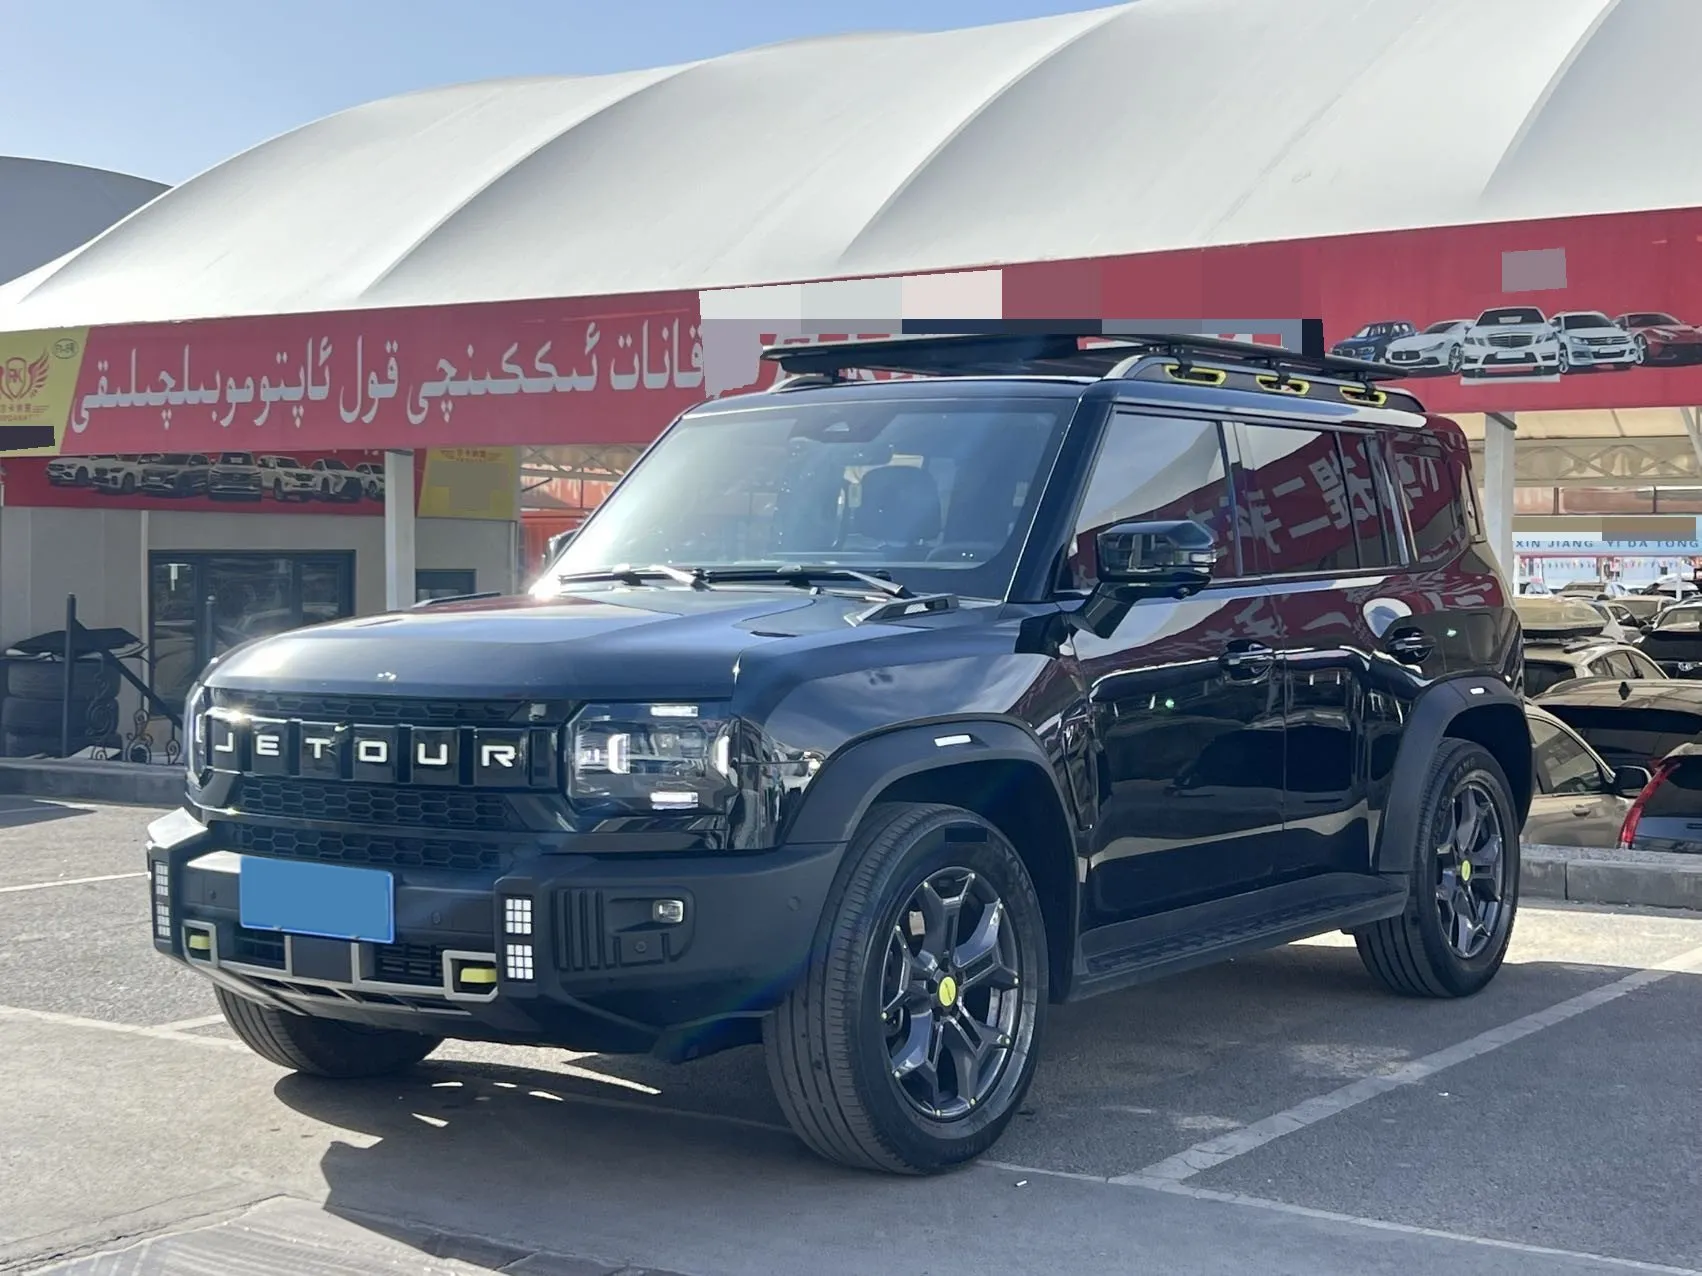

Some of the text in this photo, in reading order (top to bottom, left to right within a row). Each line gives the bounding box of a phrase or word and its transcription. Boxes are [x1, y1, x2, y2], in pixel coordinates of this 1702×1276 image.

[339, 334, 399, 424] قول
[1515, 539, 1541, 549] XIN
[1547, 539, 1594, 549] JIANG
[1627, 539, 1649, 549] DA
[214, 731, 518, 768] JETOUR
